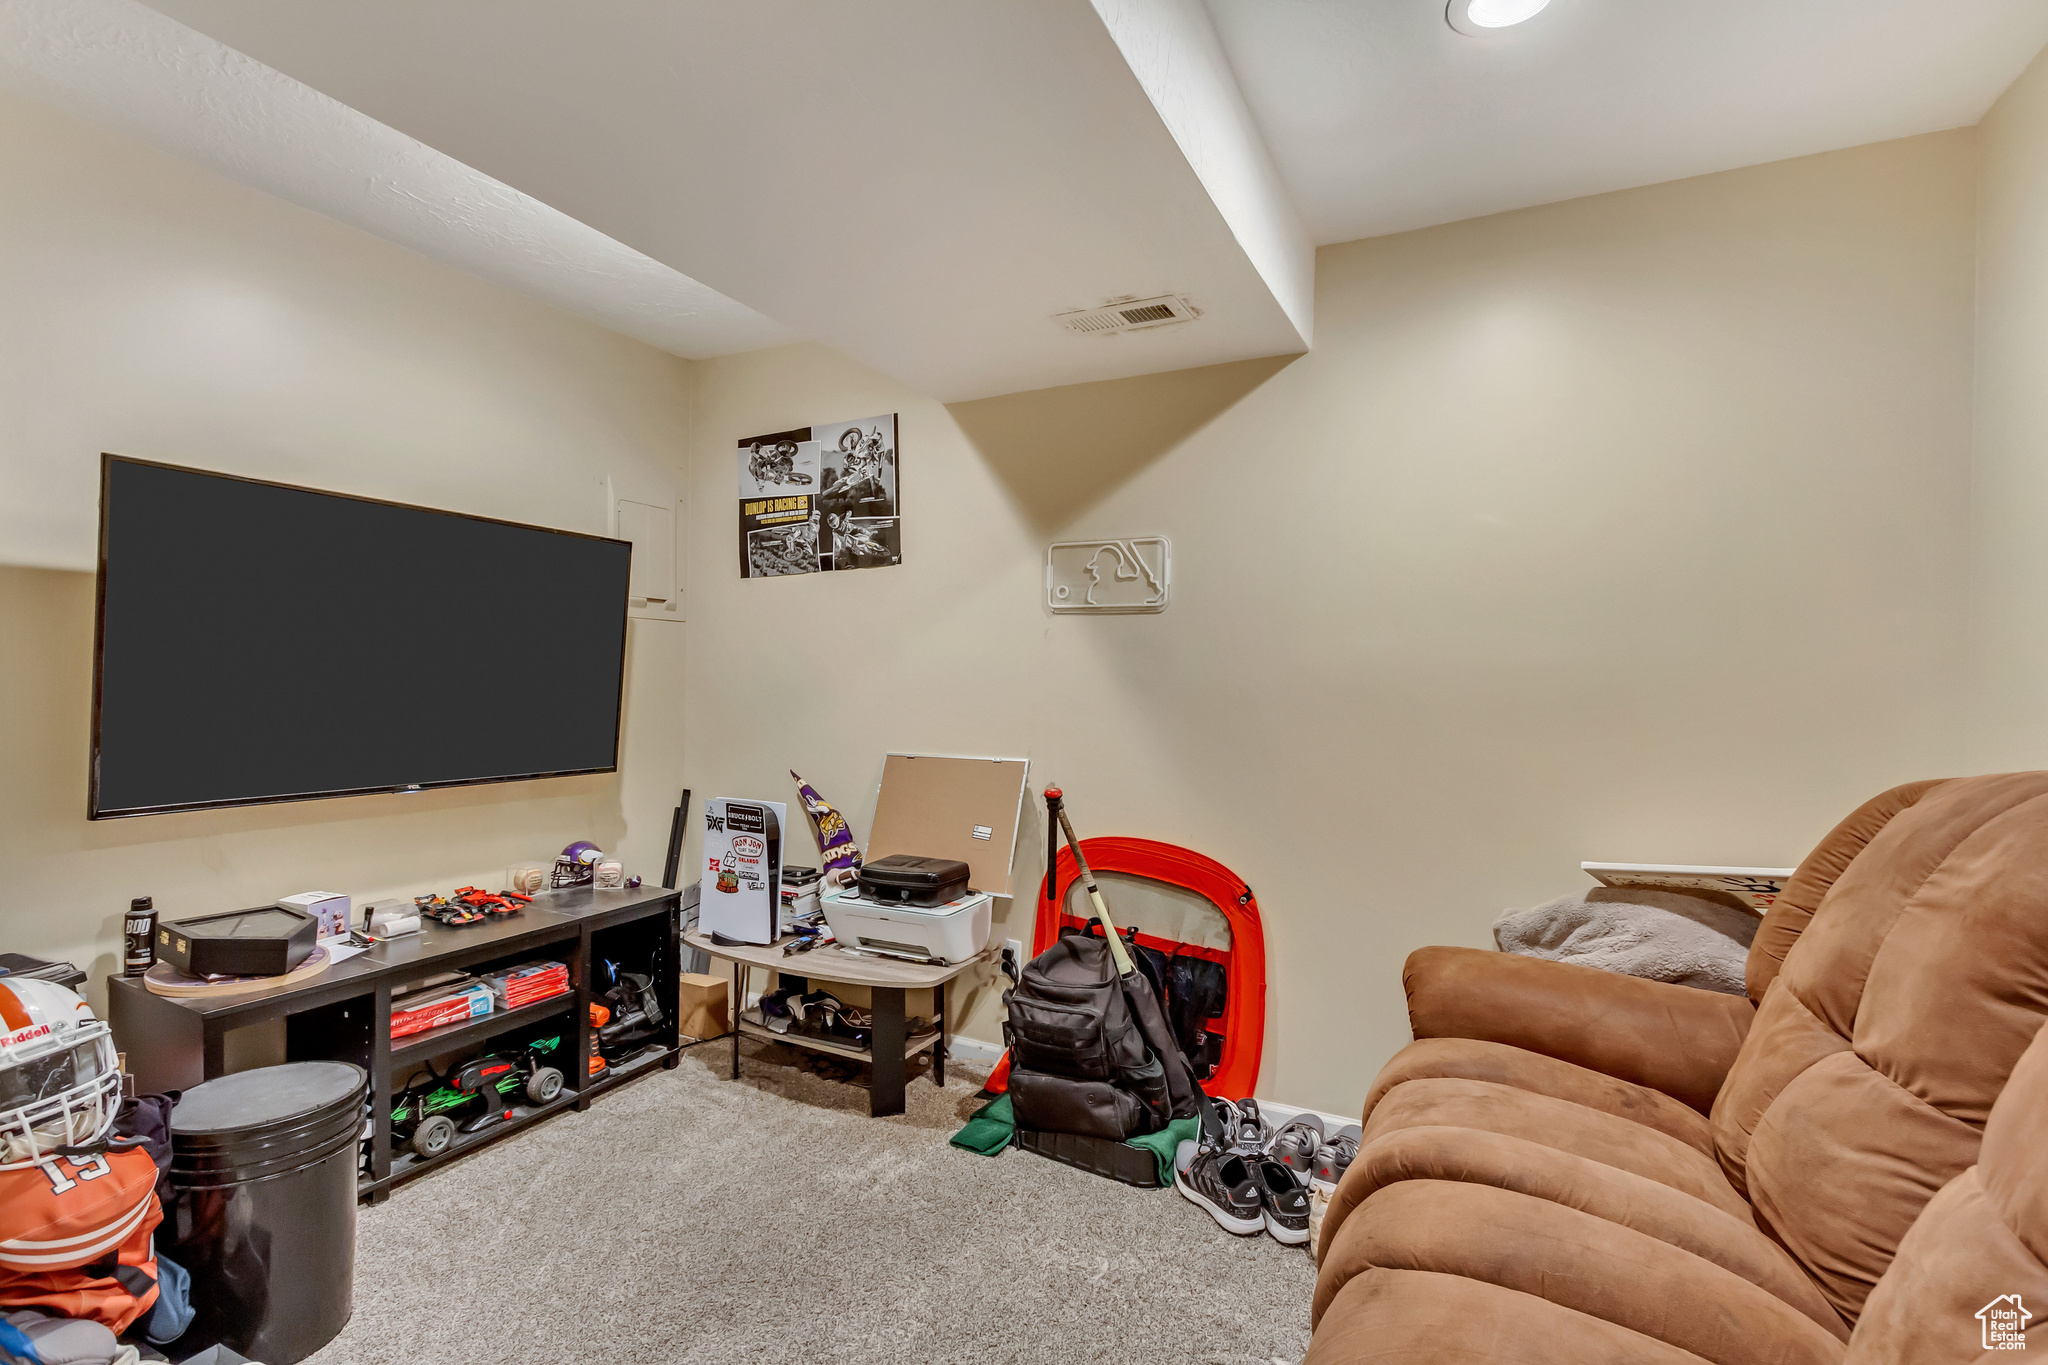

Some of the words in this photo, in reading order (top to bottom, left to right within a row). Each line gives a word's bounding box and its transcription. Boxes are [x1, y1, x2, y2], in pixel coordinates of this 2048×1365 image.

[745, 501, 766, 516] DUNLOP
[767, 499, 774, 512] IS
[775, 497, 797, 511] RACING
[728, 811, 745, 821] BRUCE
[748, 815, 763, 823] BOLT
[735, 838, 747, 848] RON
[748, 840, 762, 850] JON
[126, 918, 151, 935] BOD
[0, 1024, 50, 1048] Riddell
